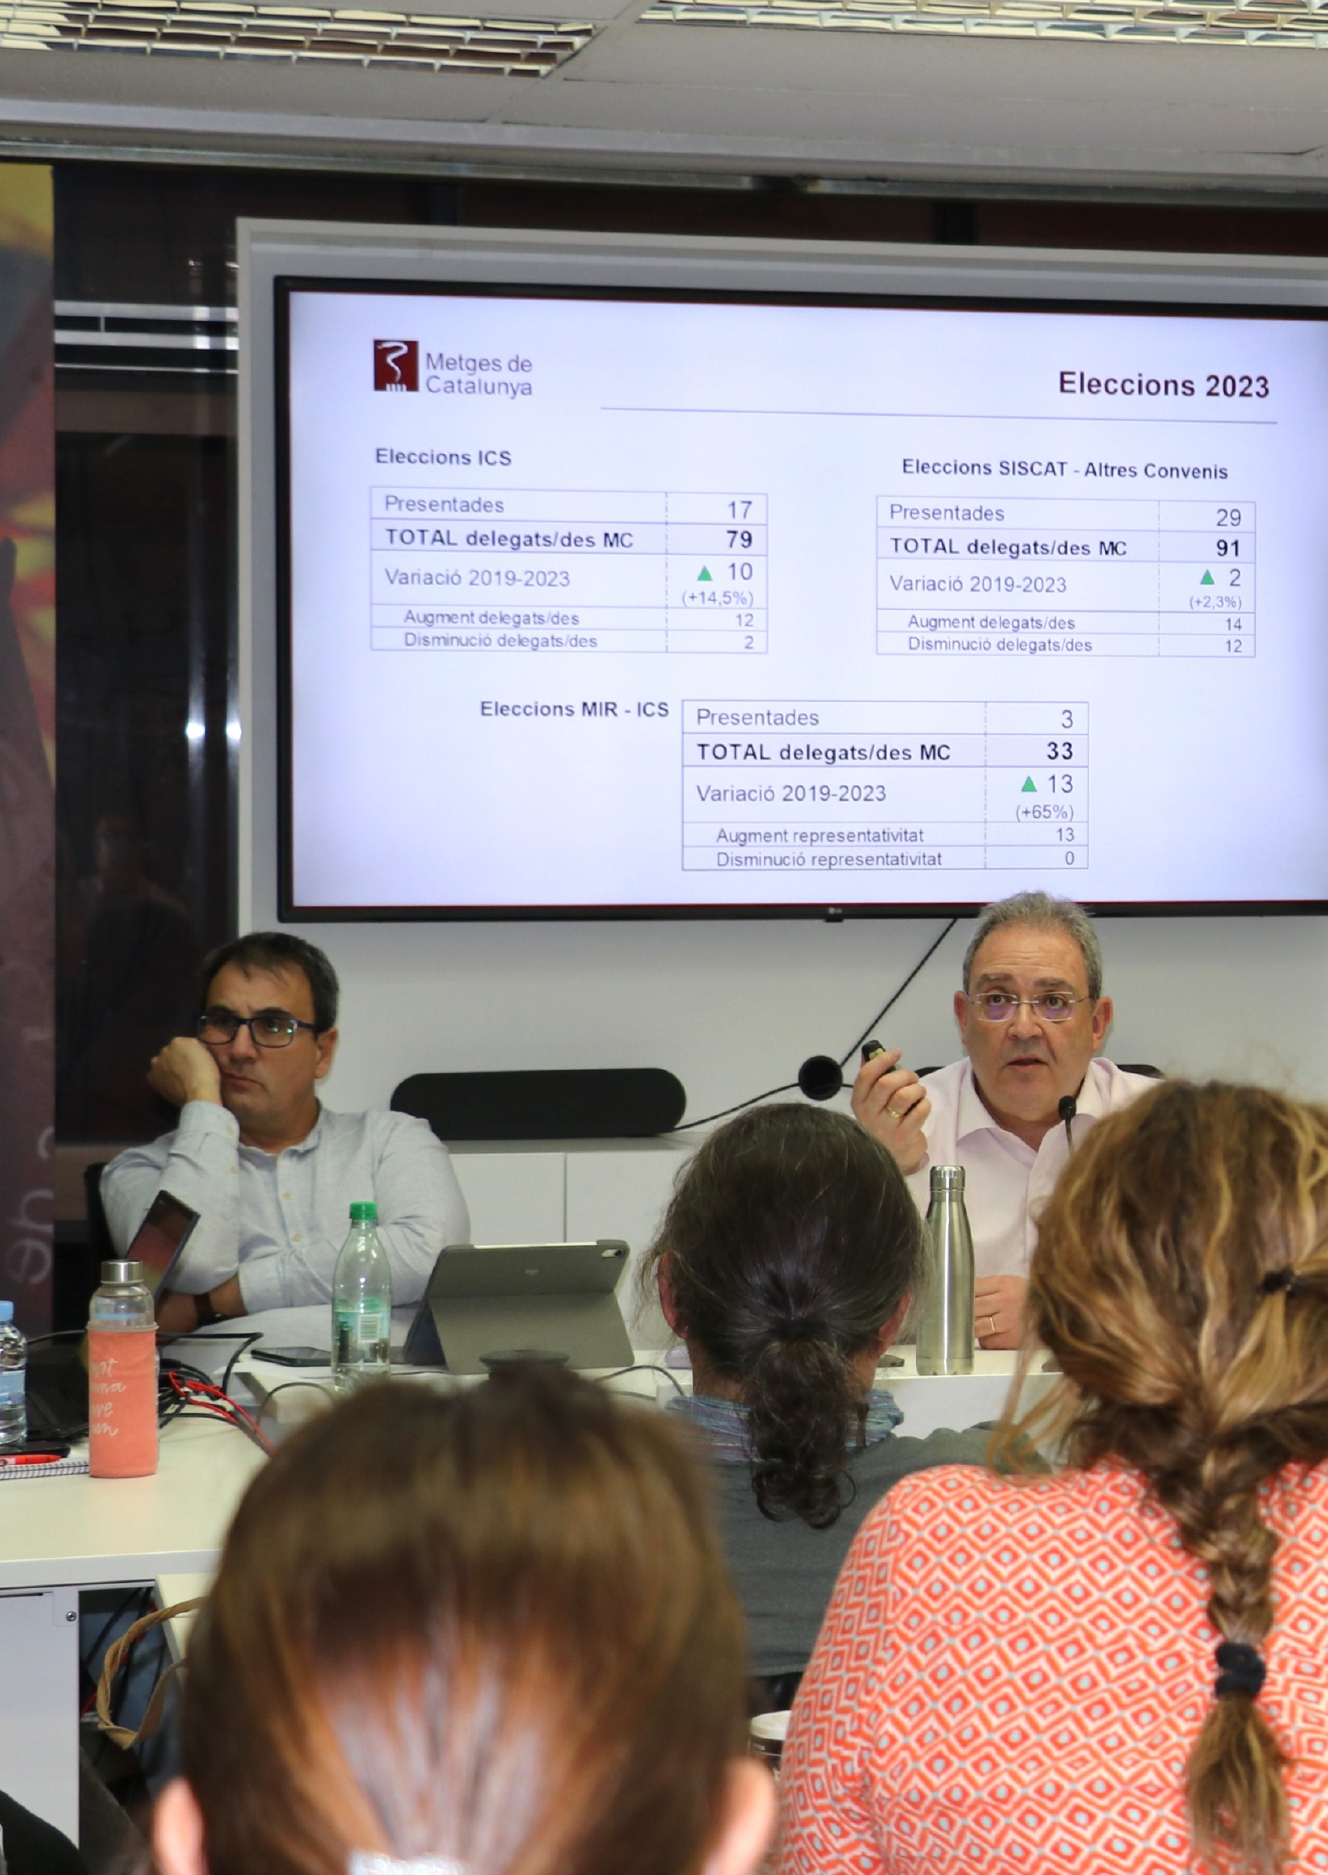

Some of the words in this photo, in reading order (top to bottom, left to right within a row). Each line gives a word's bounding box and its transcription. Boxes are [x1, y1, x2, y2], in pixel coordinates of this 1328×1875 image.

[426, 352, 502, 376] Metges
[508, 355, 532, 372] de
[426, 376, 533, 399] Catalunya
[1060, 371, 1195, 396] Eleccions
[1206, 375, 1269, 398] 2023
[376, 448, 471, 465] Eleccions
[479, 450, 511, 466] ICS
[903, 459, 992, 475] Eleccions
[1000, 461, 1067, 476] SISCAT
[1085, 462, 1137, 477] Altres
[1144, 463, 1228, 479] Convenis
[385, 495, 504, 513] Presentades
[729, 501, 752, 519] 17
[891, 504, 1004, 521] Presentades
[1217, 509, 1241, 526] 29
[386, 529, 457, 545] TOTAL
[466, 530, 595, 551] delegats/des
[604, 533, 632, 547] MC
[727, 530, 752, 548] 79
[1217, 540, 1238, 556] 91
[891, 538, 959, 554] TOTAL
[967, 539, 1090, 559] delegats/des
[1100, 541, 1126, 555] MC
[385, 568, 461, 585] Variació
[469, 569, 570, 587] 2019-2023
[729, 562, 752, 580] 10
[1230, 568, 1240, 586] 2
[890, 575, 963, 591] Variació
[970, 576, 1066, 593] 2019-2023
[682, 591, 754, 608] (+14,5%)
[1189, 595, 1242, 611] (+2,3%)
[404, 610, 474, 627] Augment
[479, 611, 579, 629] delegats/des
[736, 613, 753, 627] 12
[908, 614, 976, 633] Augment
[979, 616, 1075, 633] delegats/des
[1226, 618, 1242, 631] 14
[405, 632, 492, 647] Disminució
[497, 634, 597, 651] delegats/des
[745, 635, 753, 649] 2
[909, 637, 991, 651] Disminució
[997, 638, 1092, 655] delegats/des
[1226, 639, 1242, 652] 12
[481, 701, 574, 716] Eleccions
[583, 702, 617, 716] MIR
[638, 702, 669, 717] ICS
[698, 709, 819, 726] Presentades
[1062, 710, 1073, 728] 3
[697, 744, 771, 760] TOTAL
[780, 744, 911, 765] delegats/des
[921, 744, 950, 760] MC
[1047, 742, 1072, 760] 33
[1049, 774, 1073, 793] 13
[697, 785, 775, 801] Variació
[783, 785, 886, 801] 2019-2023
[1014, 805, 1074, 823] (+65%)
[716, 828, 788, 847] Augment
[794, 828, 924, 847] representativitat
[1057, 827, 1074, 842] 13
[717, 852, 805, 866] Disminució
[811, 852, 942, 869] representativitat
[1065, 851, 1075, 865] 0
